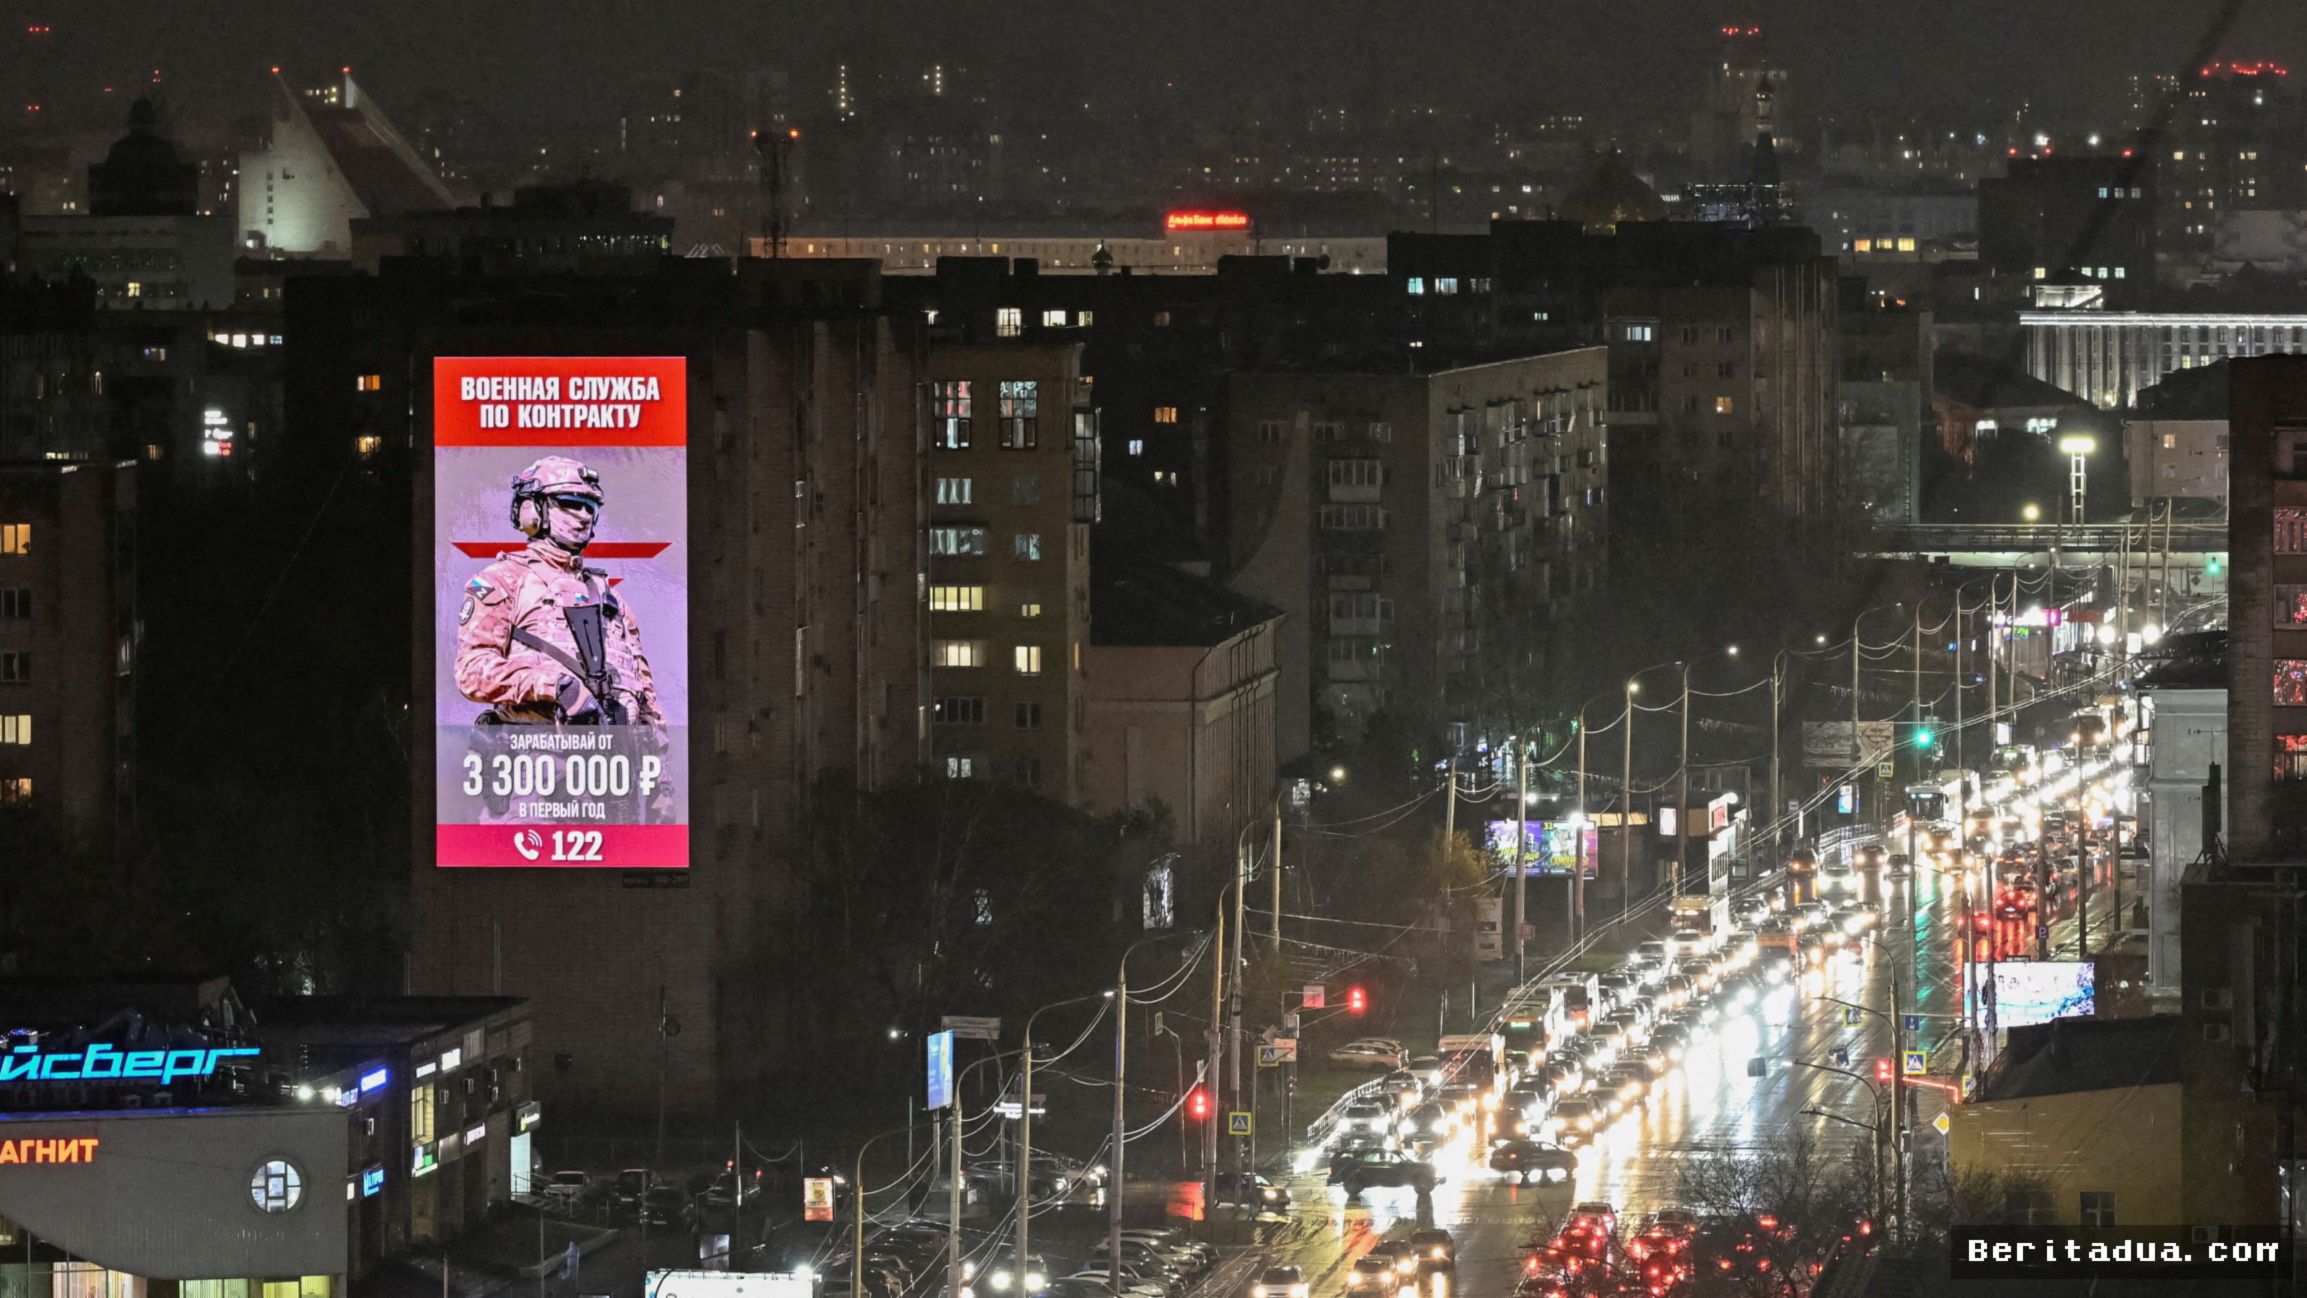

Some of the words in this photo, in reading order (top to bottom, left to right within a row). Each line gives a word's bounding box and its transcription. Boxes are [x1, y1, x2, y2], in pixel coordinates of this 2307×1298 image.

[461, 376, 560, 401] ВОЕННАЯ
[569, 376, 660, 401] СЛУЖБА
[480, 404, 509, 428] ПО
[518, 404, 641, 428] КОНТРАКТУ
[510, 732, 595, 750] ЗАРАБАТЫВАЙ
[598, 734, 613, 750] ОТ
[463, 754, 483, 796] 3
[492, 754, 556, 796] 300
[566, 754, 630, 796] 000
[519, 803, 527, 818] В
[530, 800, 579, 818] ПЕРВЫЙ
[582, 803, 606, 819] ГОД
[551, 831, 603, 861] 122
